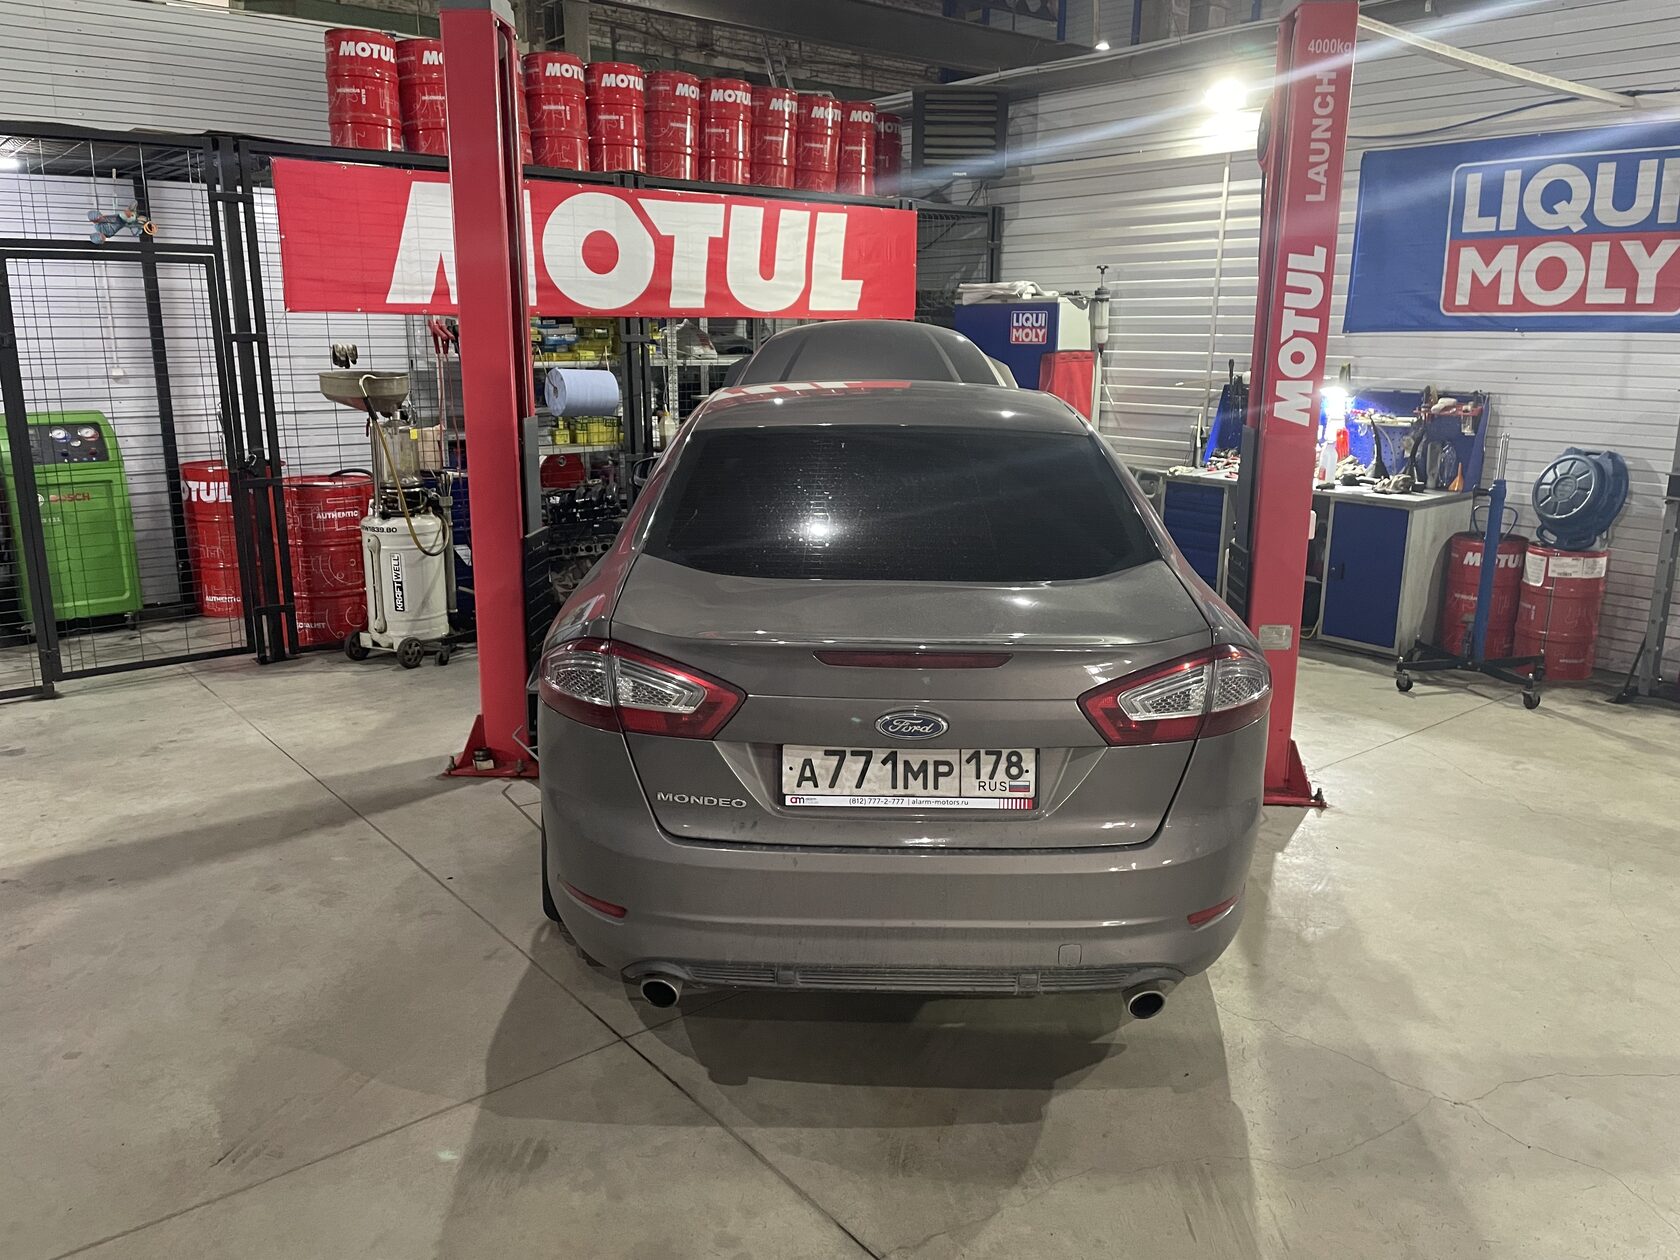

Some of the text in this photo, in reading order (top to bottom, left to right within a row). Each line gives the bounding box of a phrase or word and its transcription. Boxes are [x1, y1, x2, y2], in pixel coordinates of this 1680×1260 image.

[339, 41, 396, 63] MOTUL
[1308, 38, 1351, 56] 4000kg
[1305, 71, 1337, 202] LAUNCH
[1462, 157, 1680, 233] LIQUI
[1455, 239, 1680, 307] MOLY
[1013, 313, 1045, 327] LIQUI
[1012, 328, 1045, 342] MOLY
[1273, 245, 1327, 427] MOTUL
[316, 510, 359, 519] AUTHENTIC
[889, 718, 934, 734] Ford
[796, 750, 954, 790] A771MP
[965, 750, 1023, 780] 178
[978, 781, 1007, 792] RUS
[657, 791, 747, 808] MONDEO
[849, 797, 867, 806] (812)
[911, 798, 969, 806] alarm-motors.ru
